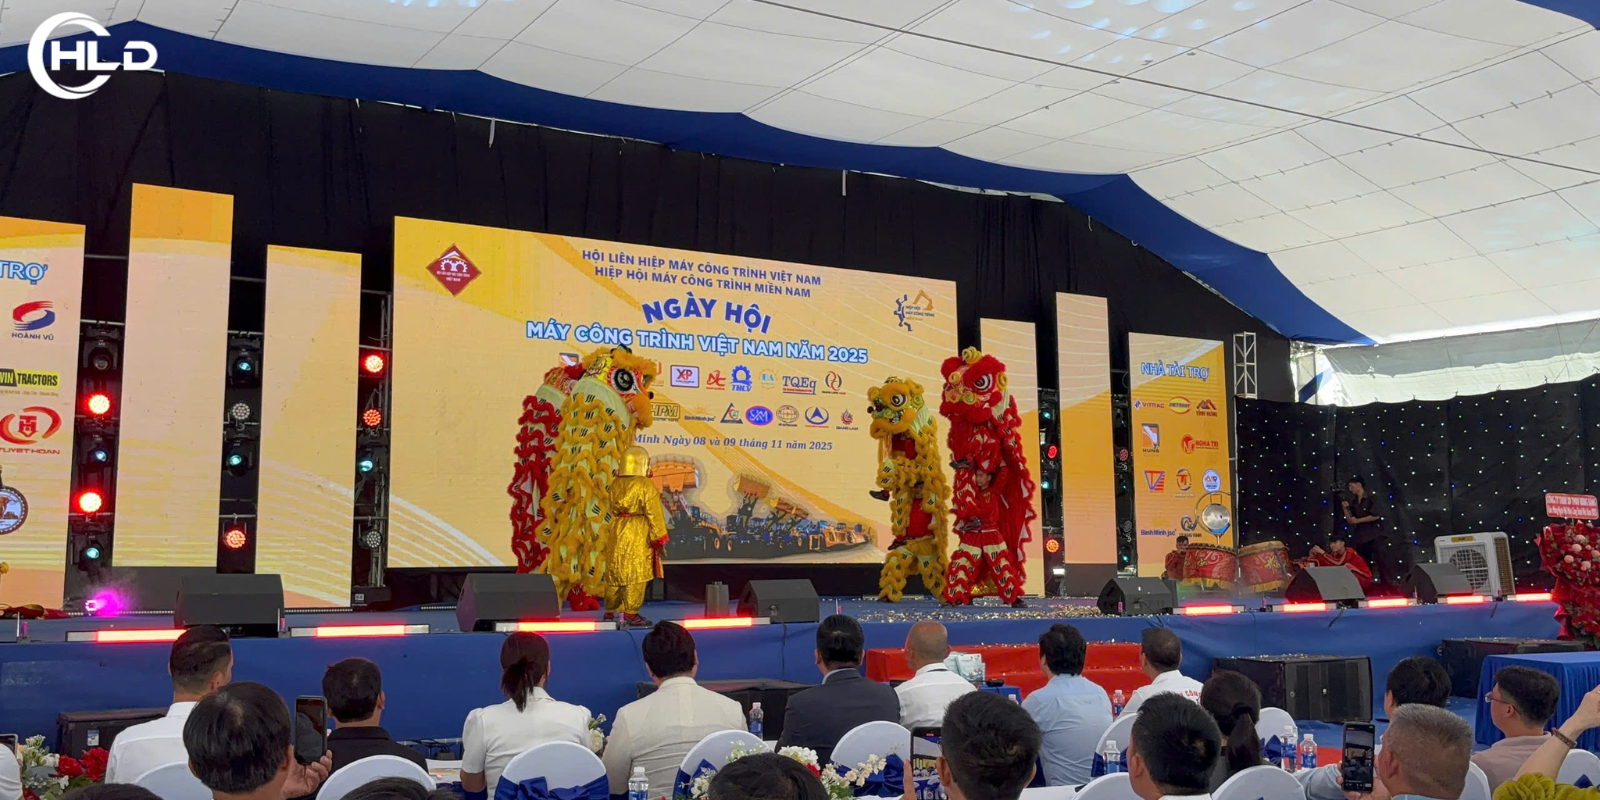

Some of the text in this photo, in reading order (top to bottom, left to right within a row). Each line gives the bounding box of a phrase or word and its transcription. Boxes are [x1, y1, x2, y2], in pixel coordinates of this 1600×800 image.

[582, 249, 821, 285] HỘI LIÊN HIỆP MÁY CÔNG TRÌNH VIỆT NAM
[595, 265, 811, 298] HIỆP HỘI MÁY CÔNG TRÌNH MIỀN NAM
[641, 291, 772, 334] NGÀY HỘI
[12, 332, 41, 340] HOÀNH
[526, 318, 869, 364] MÁY CÔNG TRÌNH VIỆT NAM NĂM 2025
[17, 372, 58, 387] TRACTORS
[1141, 360, 1210, 382] NHÀ TÀI TRỢ
[663, 435, 691, 447] Ngày
[693, 436, 706, 446] 08
[709, 437, 720, 446] và
[723, 437, 736, 446] 09
[739, 437, 768, 450] tháng
[771, 439, 783, 449] 11
[786, 441, 807, 450] năm
[809, 441, 833, 451] 2025
